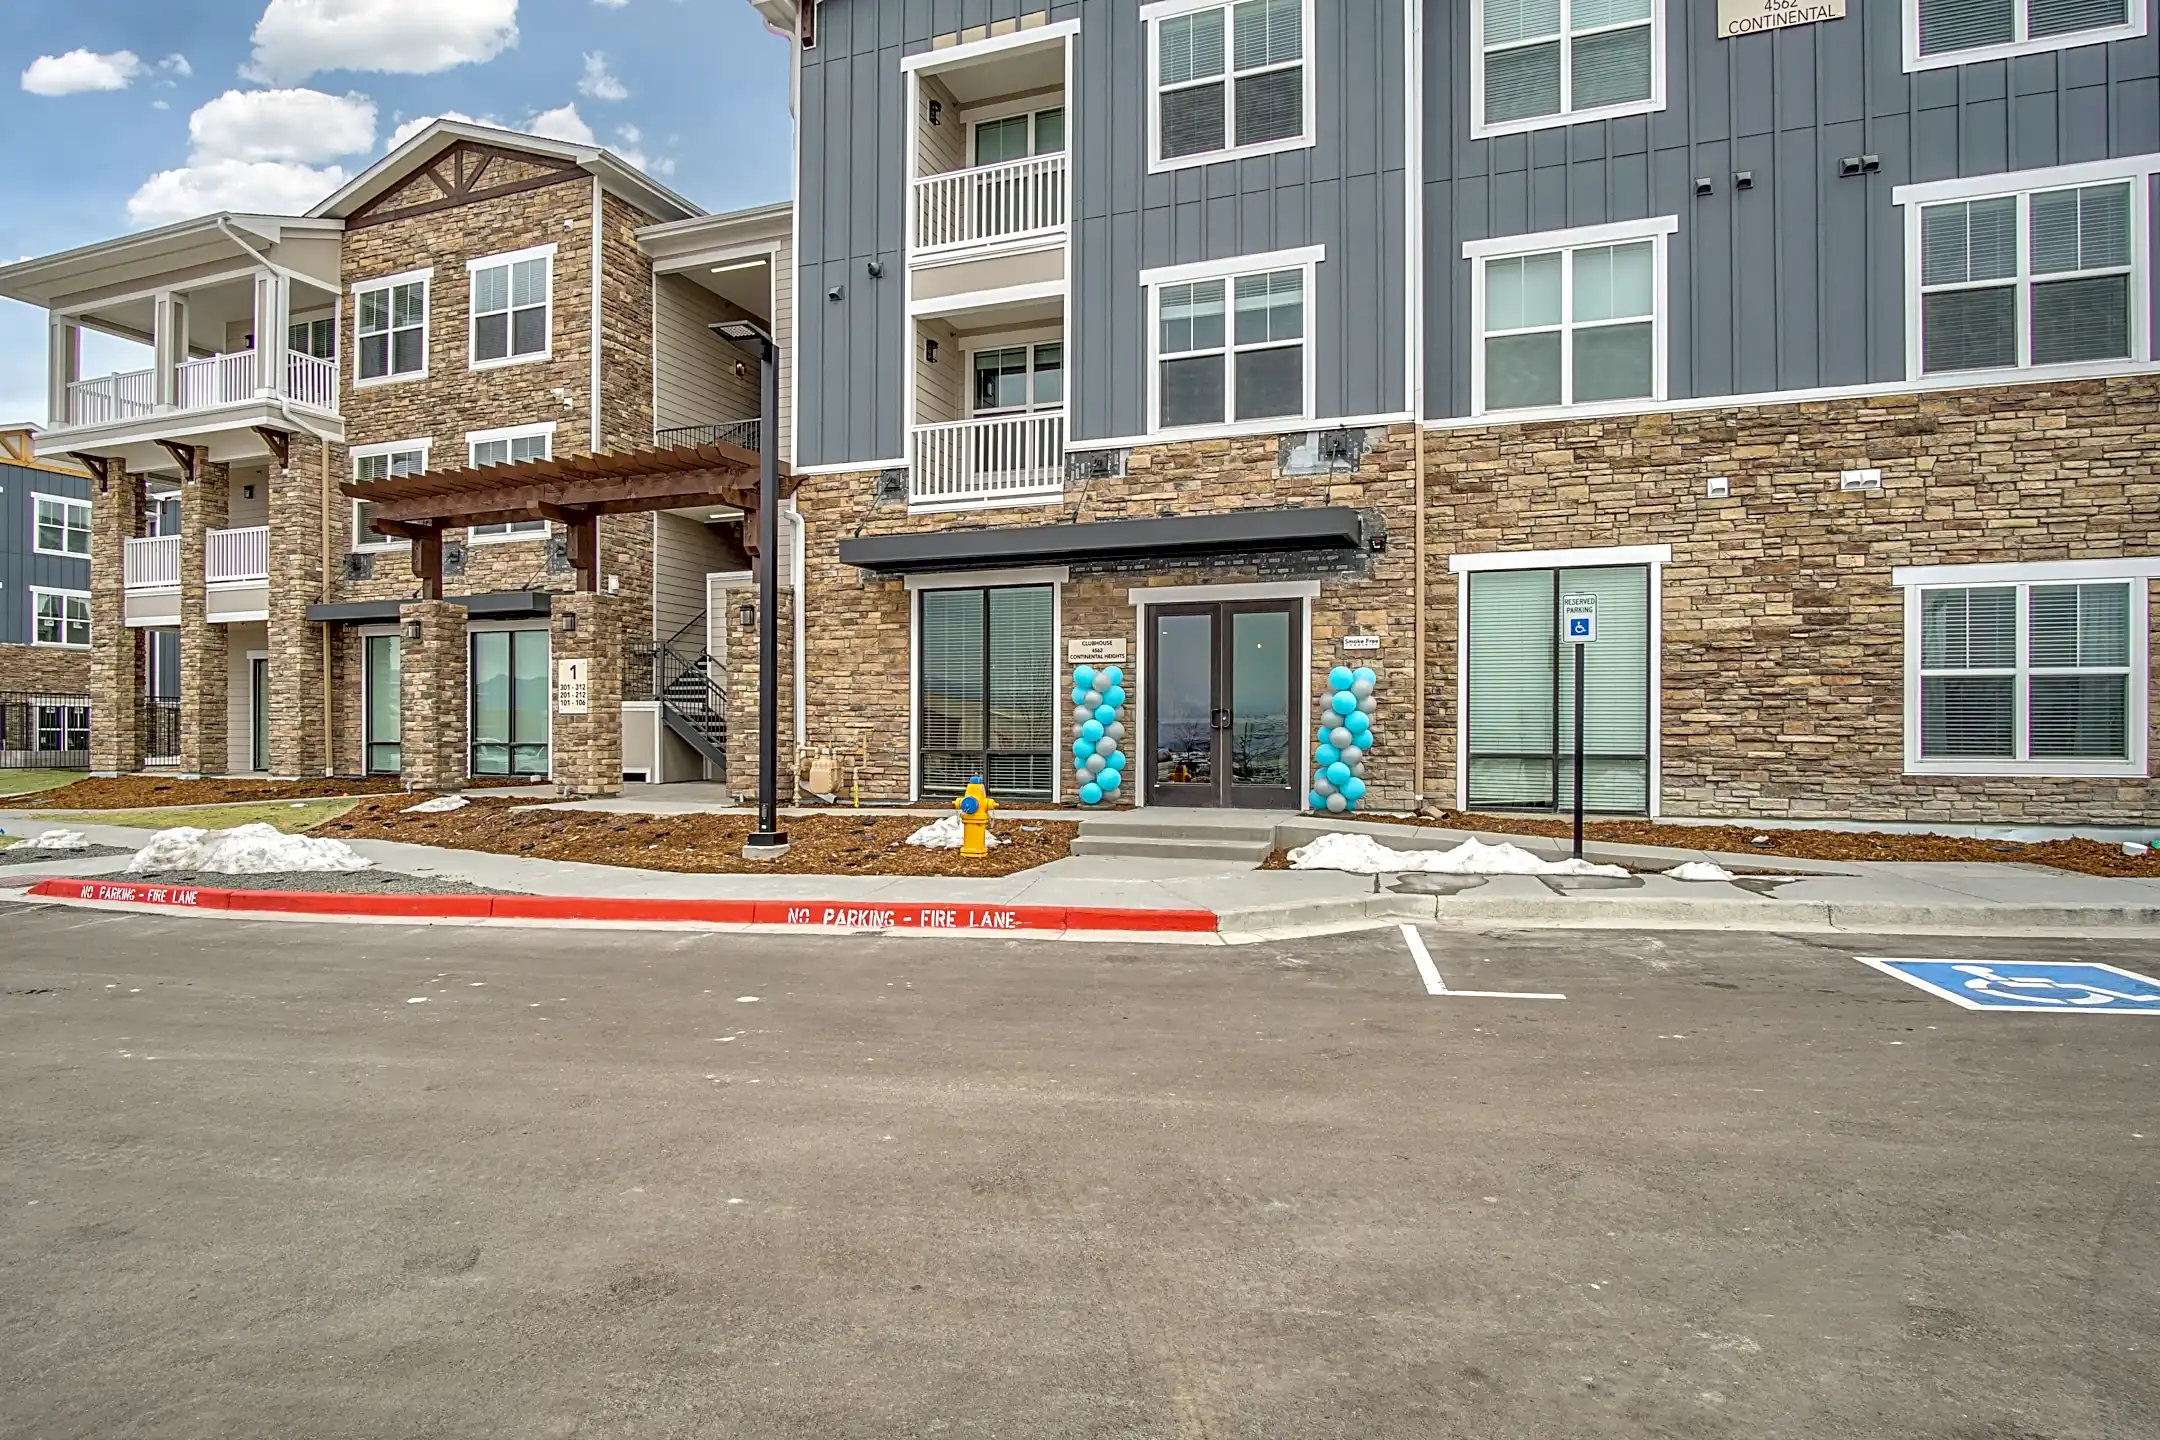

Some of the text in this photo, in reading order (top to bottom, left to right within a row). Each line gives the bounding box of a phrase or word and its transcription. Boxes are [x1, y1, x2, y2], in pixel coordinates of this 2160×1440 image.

[1764, 0, 1798, 11] 4562
[1728, 5, 1836, 34] CONTINENTAL
[1565, 598, 1595, 606] RESERVED
[1566, 606, 1593, 614] PARKING
[570, 664, 577, 680] 1
[80, 885, 94, 899] NO
[99, 886, 136, 901] PARKING
[147, 888, 168, 903] FIRE
[172, 890, 198, 905] LANE
[788, 907, 810, 924] NO
[823, 908, 895, 928] PARKING
[920, 909, 957, 928] FIRE
[967, 910, 1017, 929] LANE
